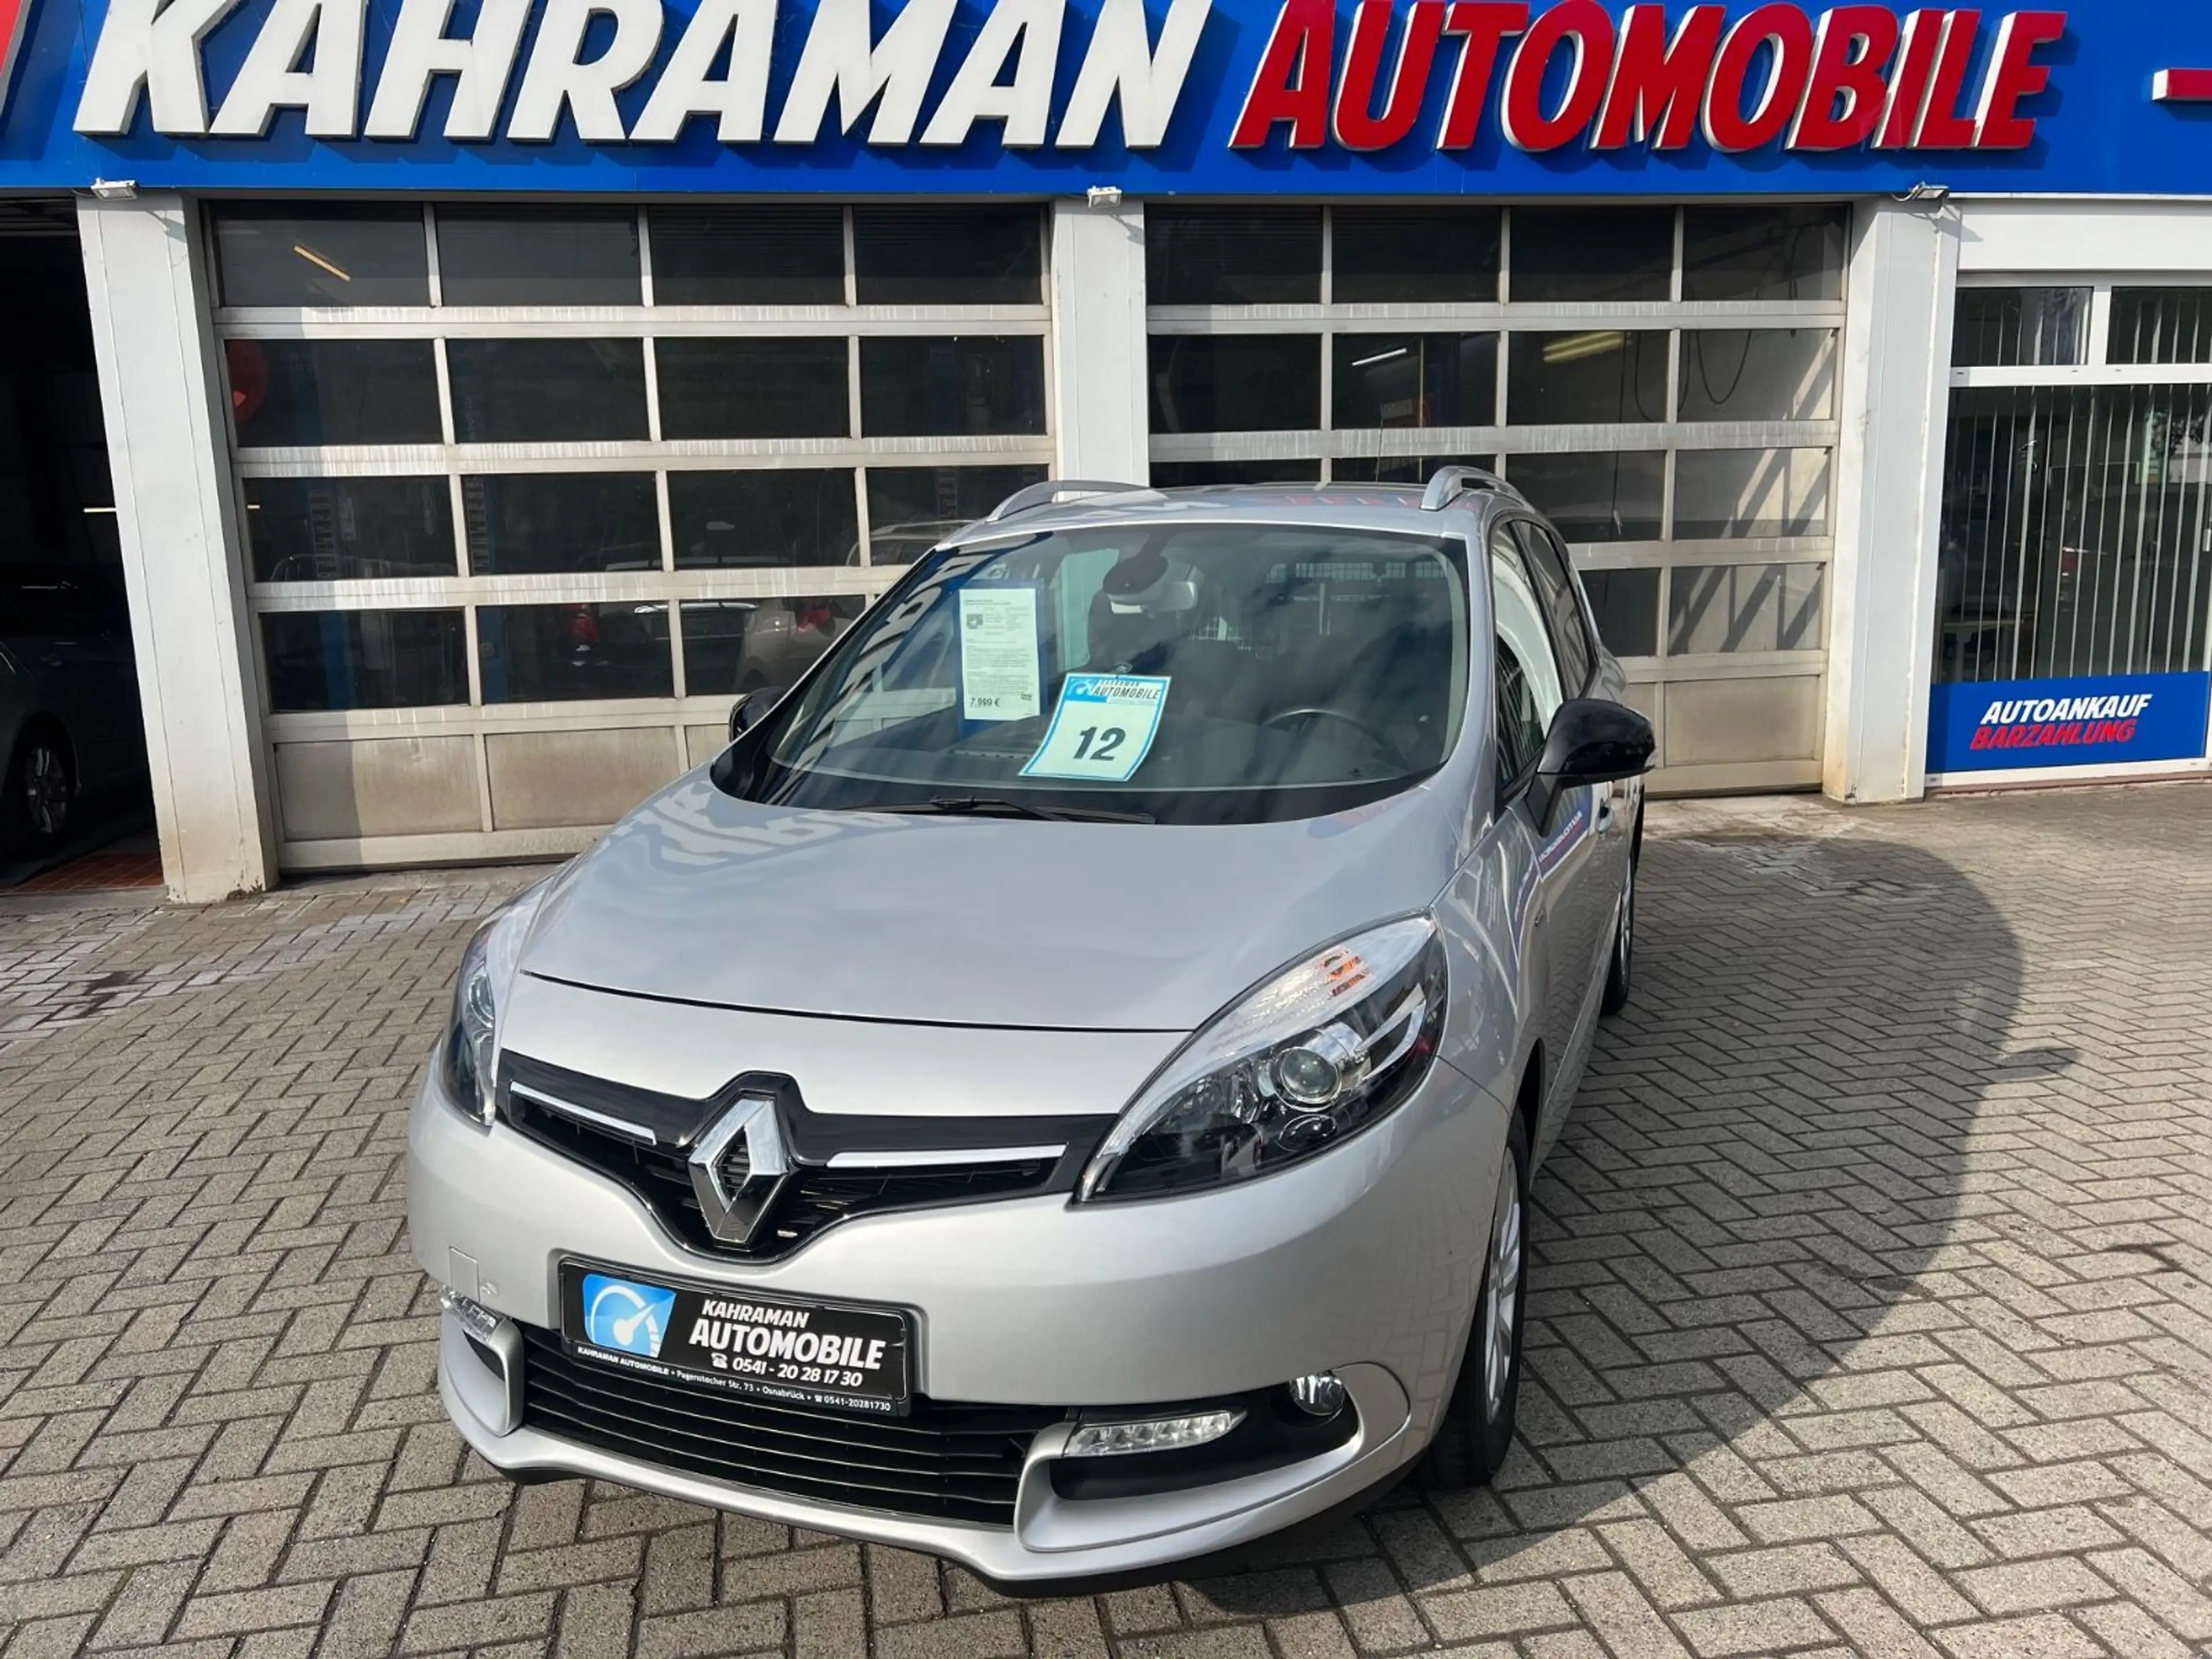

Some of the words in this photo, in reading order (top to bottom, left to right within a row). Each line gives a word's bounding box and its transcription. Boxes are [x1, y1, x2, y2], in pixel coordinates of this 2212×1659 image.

[73, 0, 1213, 146] KAHRAMAN
[1228, 0, 2067, 151] AUTOMOBILE
[994, 698, 1000, 707] €
[1093, 686, 1161, 699] AUTOMOBILE
[1980, 694, 2153, 724] AUTOANKAUF
[1073, 726, 1126, 760] 12
[1969, 719, 2137, 749] BARZAHLUNG
[702, 1299, 810, 1328] KAHRAMAN
[688, 1318, 886, 1370] AUTOMOBILE
[577, 1346, 619, 1363] KAHRAMAN
[620, 1358, 669, 1376] AUTOMOBILE
[728, 1380, 742, 1391] Str.
[744, 1382, 755, 1392] 73
[763, 1386, 805, 1400] Osnabrück
[733, 1357, 767, 1375] 0541
[778, 1364, 798, 1379] 20
[800, 1367, 820, 1382] 28
[824, 1369, 839, 1384] 17
[840, 1372, 863, 1387] 30
